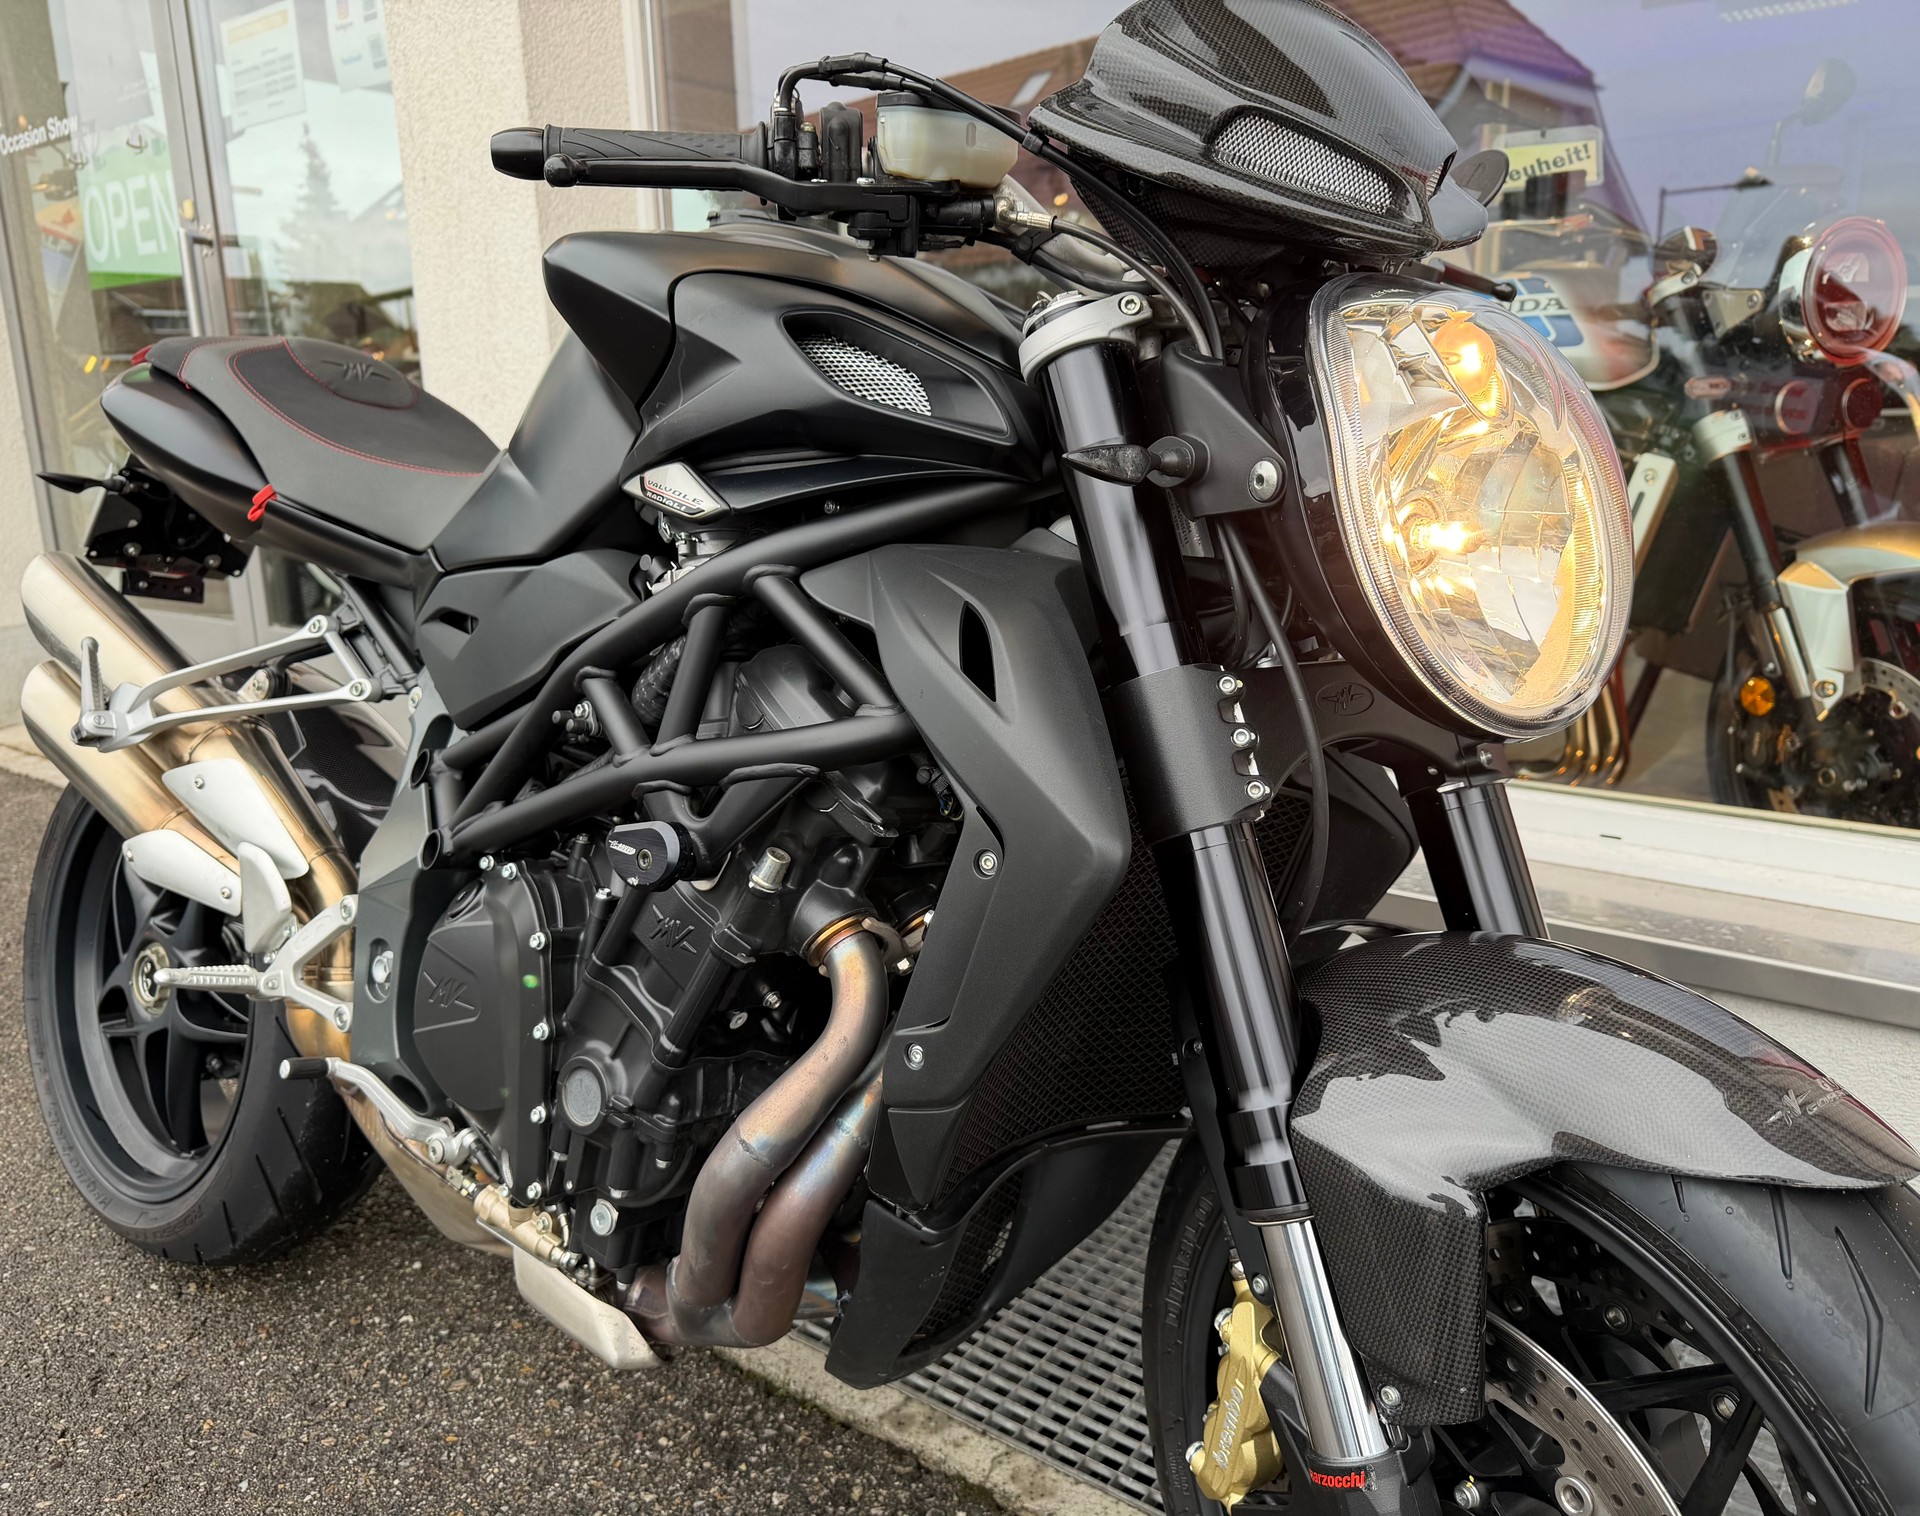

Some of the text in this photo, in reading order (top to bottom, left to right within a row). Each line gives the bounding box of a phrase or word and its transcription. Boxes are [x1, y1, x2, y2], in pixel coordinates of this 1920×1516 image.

[0, 114, 79, 156] Occasion Show
[1504, 143, 1592, 184] euheit!
[83, 168, 181, 263] OPEN
[646, 491, 688, 512] RADIALI
[647, 479, 704, 506] VALVOLE
[1212, 1385, 1244, 1471] brembo
